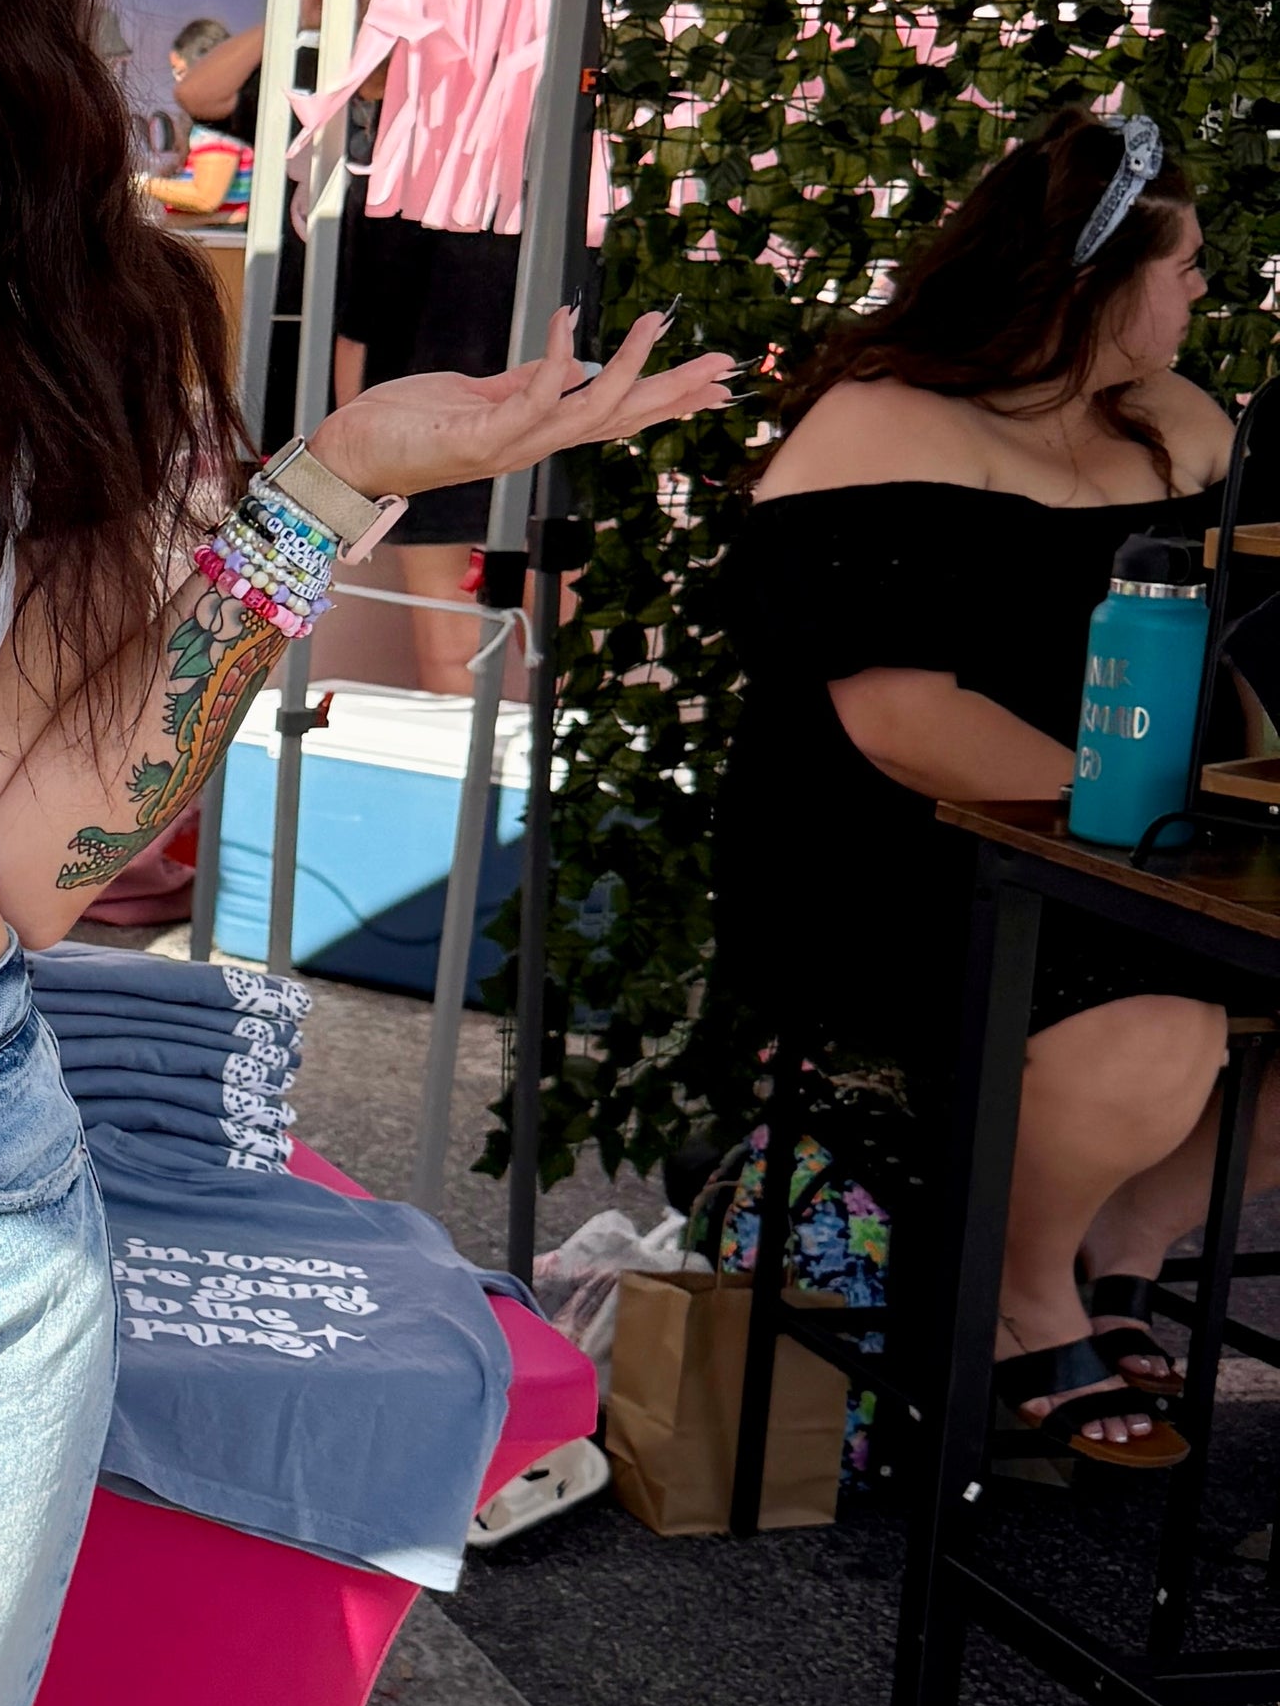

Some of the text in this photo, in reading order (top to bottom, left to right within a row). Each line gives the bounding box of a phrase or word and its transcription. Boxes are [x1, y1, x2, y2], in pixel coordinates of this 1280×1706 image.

[123, 1288, 299, 1332] to the
[196, 1273, 380, 1316] going
